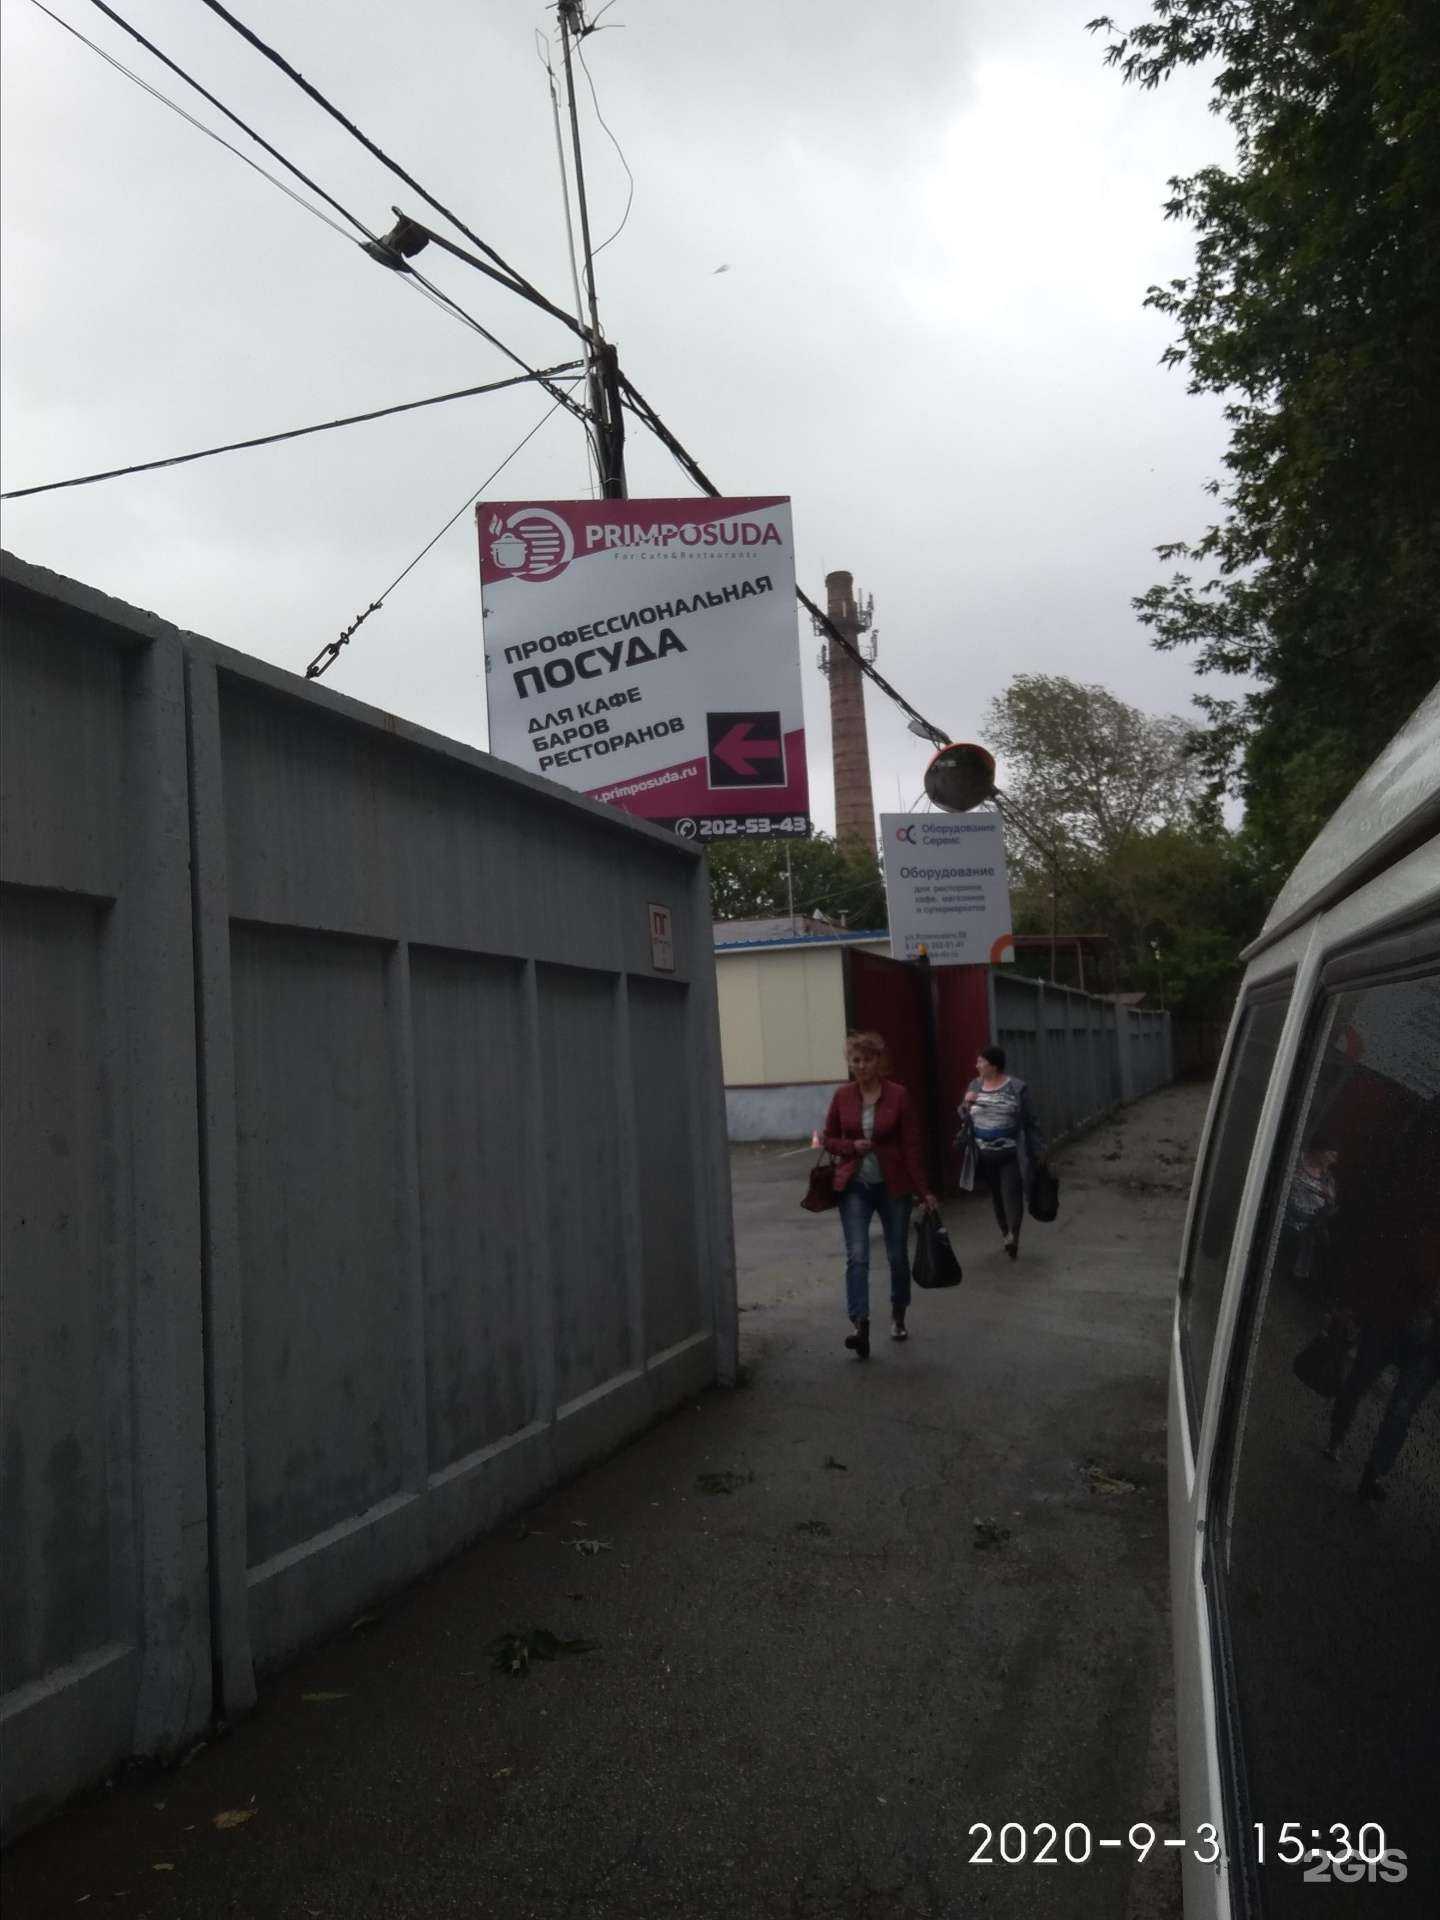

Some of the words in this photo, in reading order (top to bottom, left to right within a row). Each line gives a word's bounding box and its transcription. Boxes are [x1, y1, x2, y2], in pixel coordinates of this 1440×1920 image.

[585, 521, 783, 550] PRIMPOSUDA
[503, 575, 774, 665] ПРОФЕССИОНАЛЬНАЯ
[512, 627, 688, 700] ПОСУДА
[527, 707, 574, 735] ДЛЯ
[577, 686, 643, 718] КАФЕ
[532, 718, 611, 752] БАРОВ
[538, 716, 685, 771] РЕСТОРАНОВ
[699, 816, 807, 836] 202-53-43
[921, 823, 996, 835] Оборудование
[899, 866, 996, 881] Оборудование
